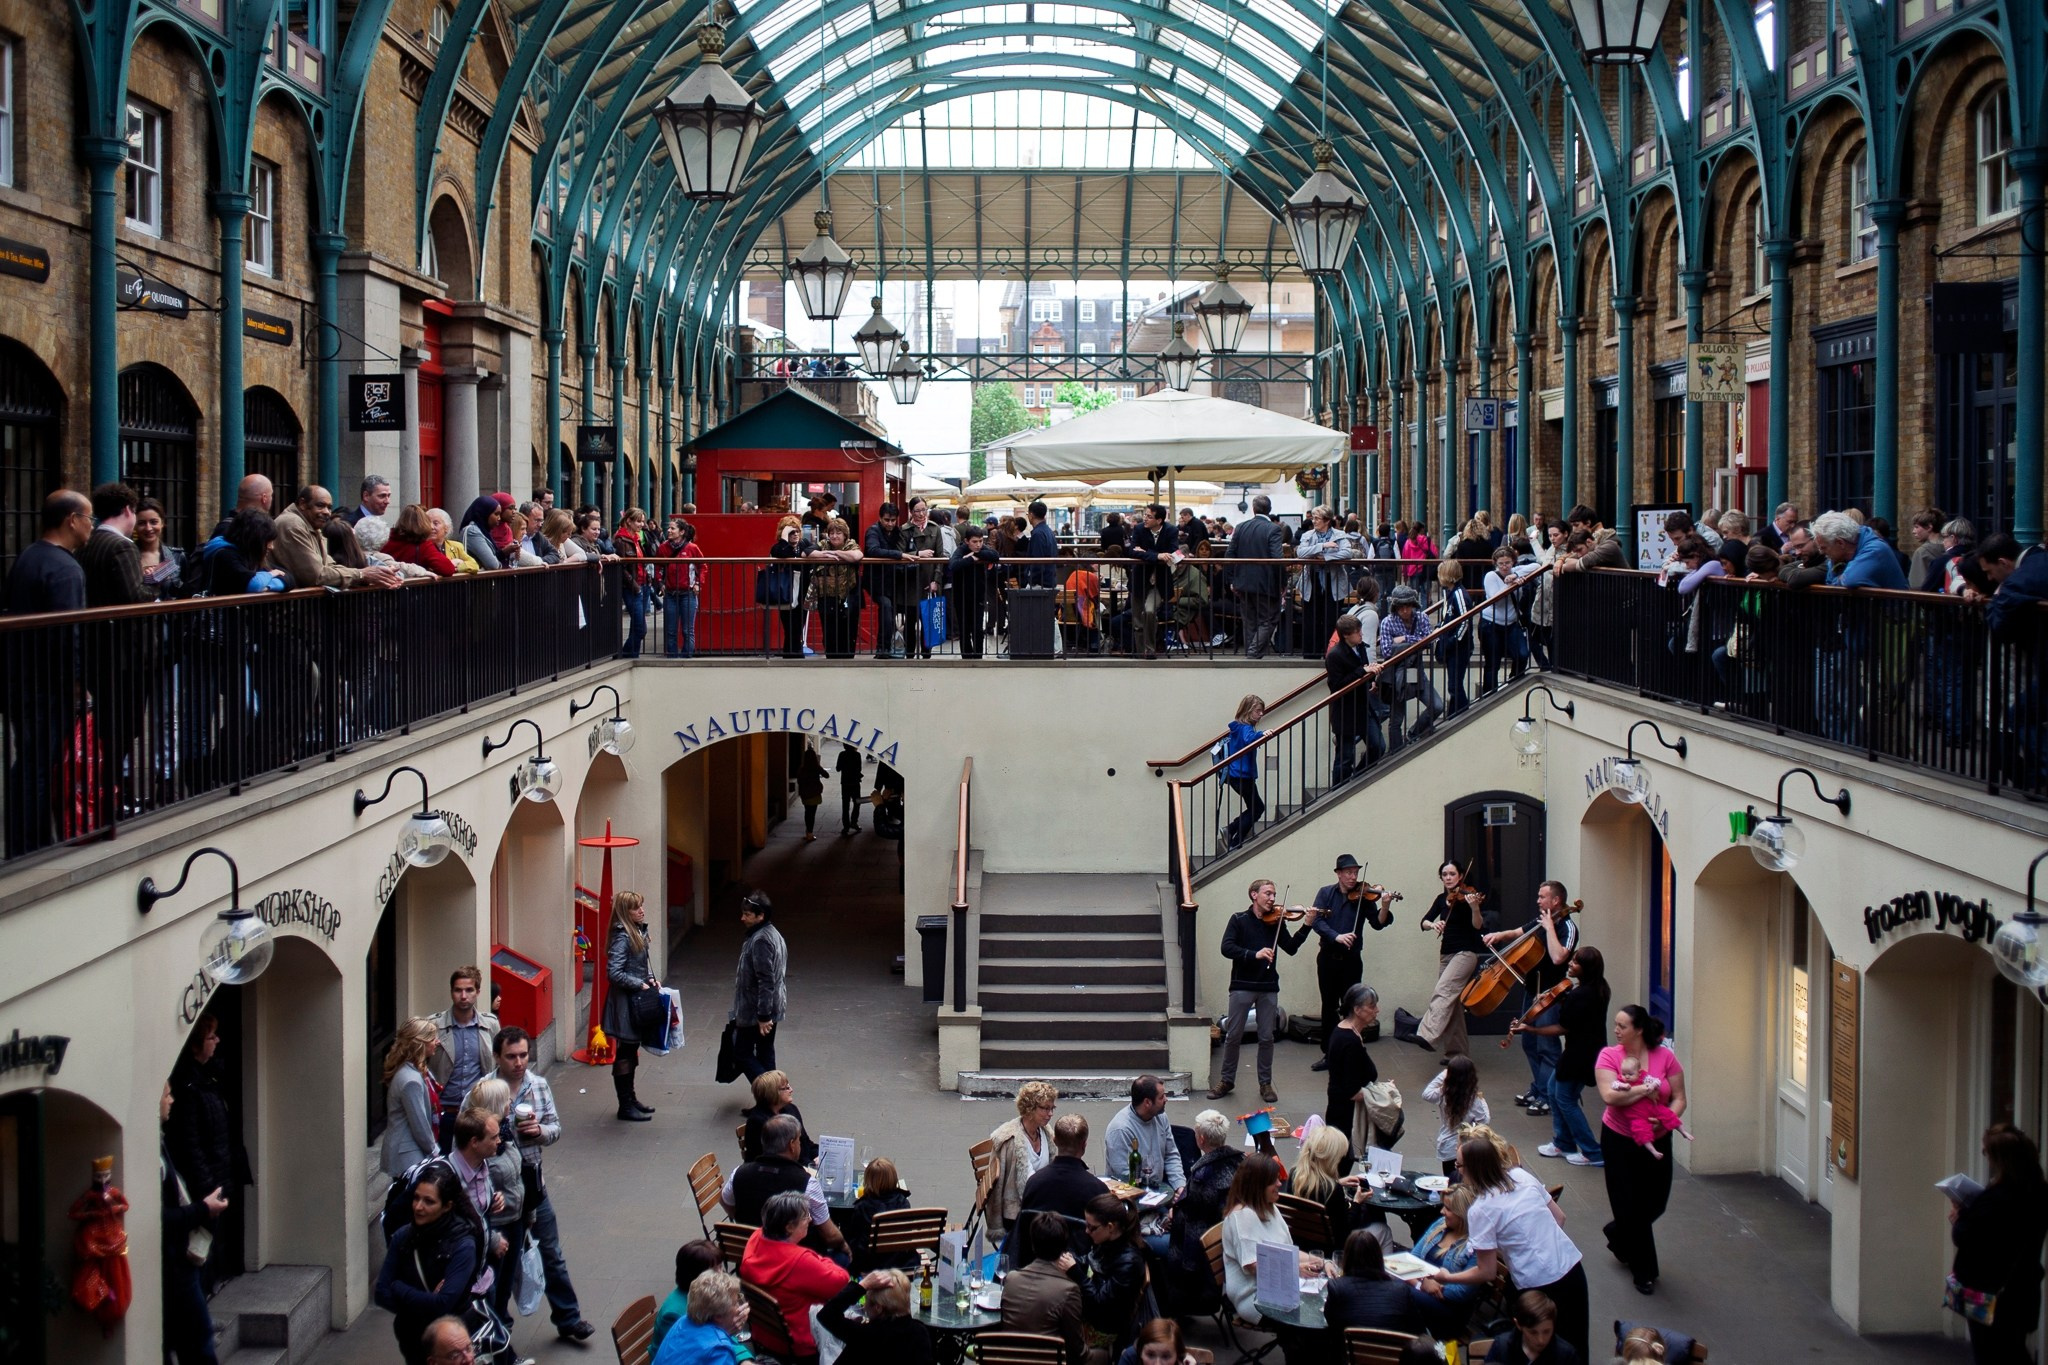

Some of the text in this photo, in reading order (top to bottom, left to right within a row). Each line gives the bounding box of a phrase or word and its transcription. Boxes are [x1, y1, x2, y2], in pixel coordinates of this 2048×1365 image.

[151, 291, 183, 308] QUOTIDIEN
[1689, 391, 1705, 401] TOY
[673, 707, 901, 766] NAUTICALIA
[254, 888, 341, 942] WORKSHOP
[1863, 890, 1931, 944] frozen
